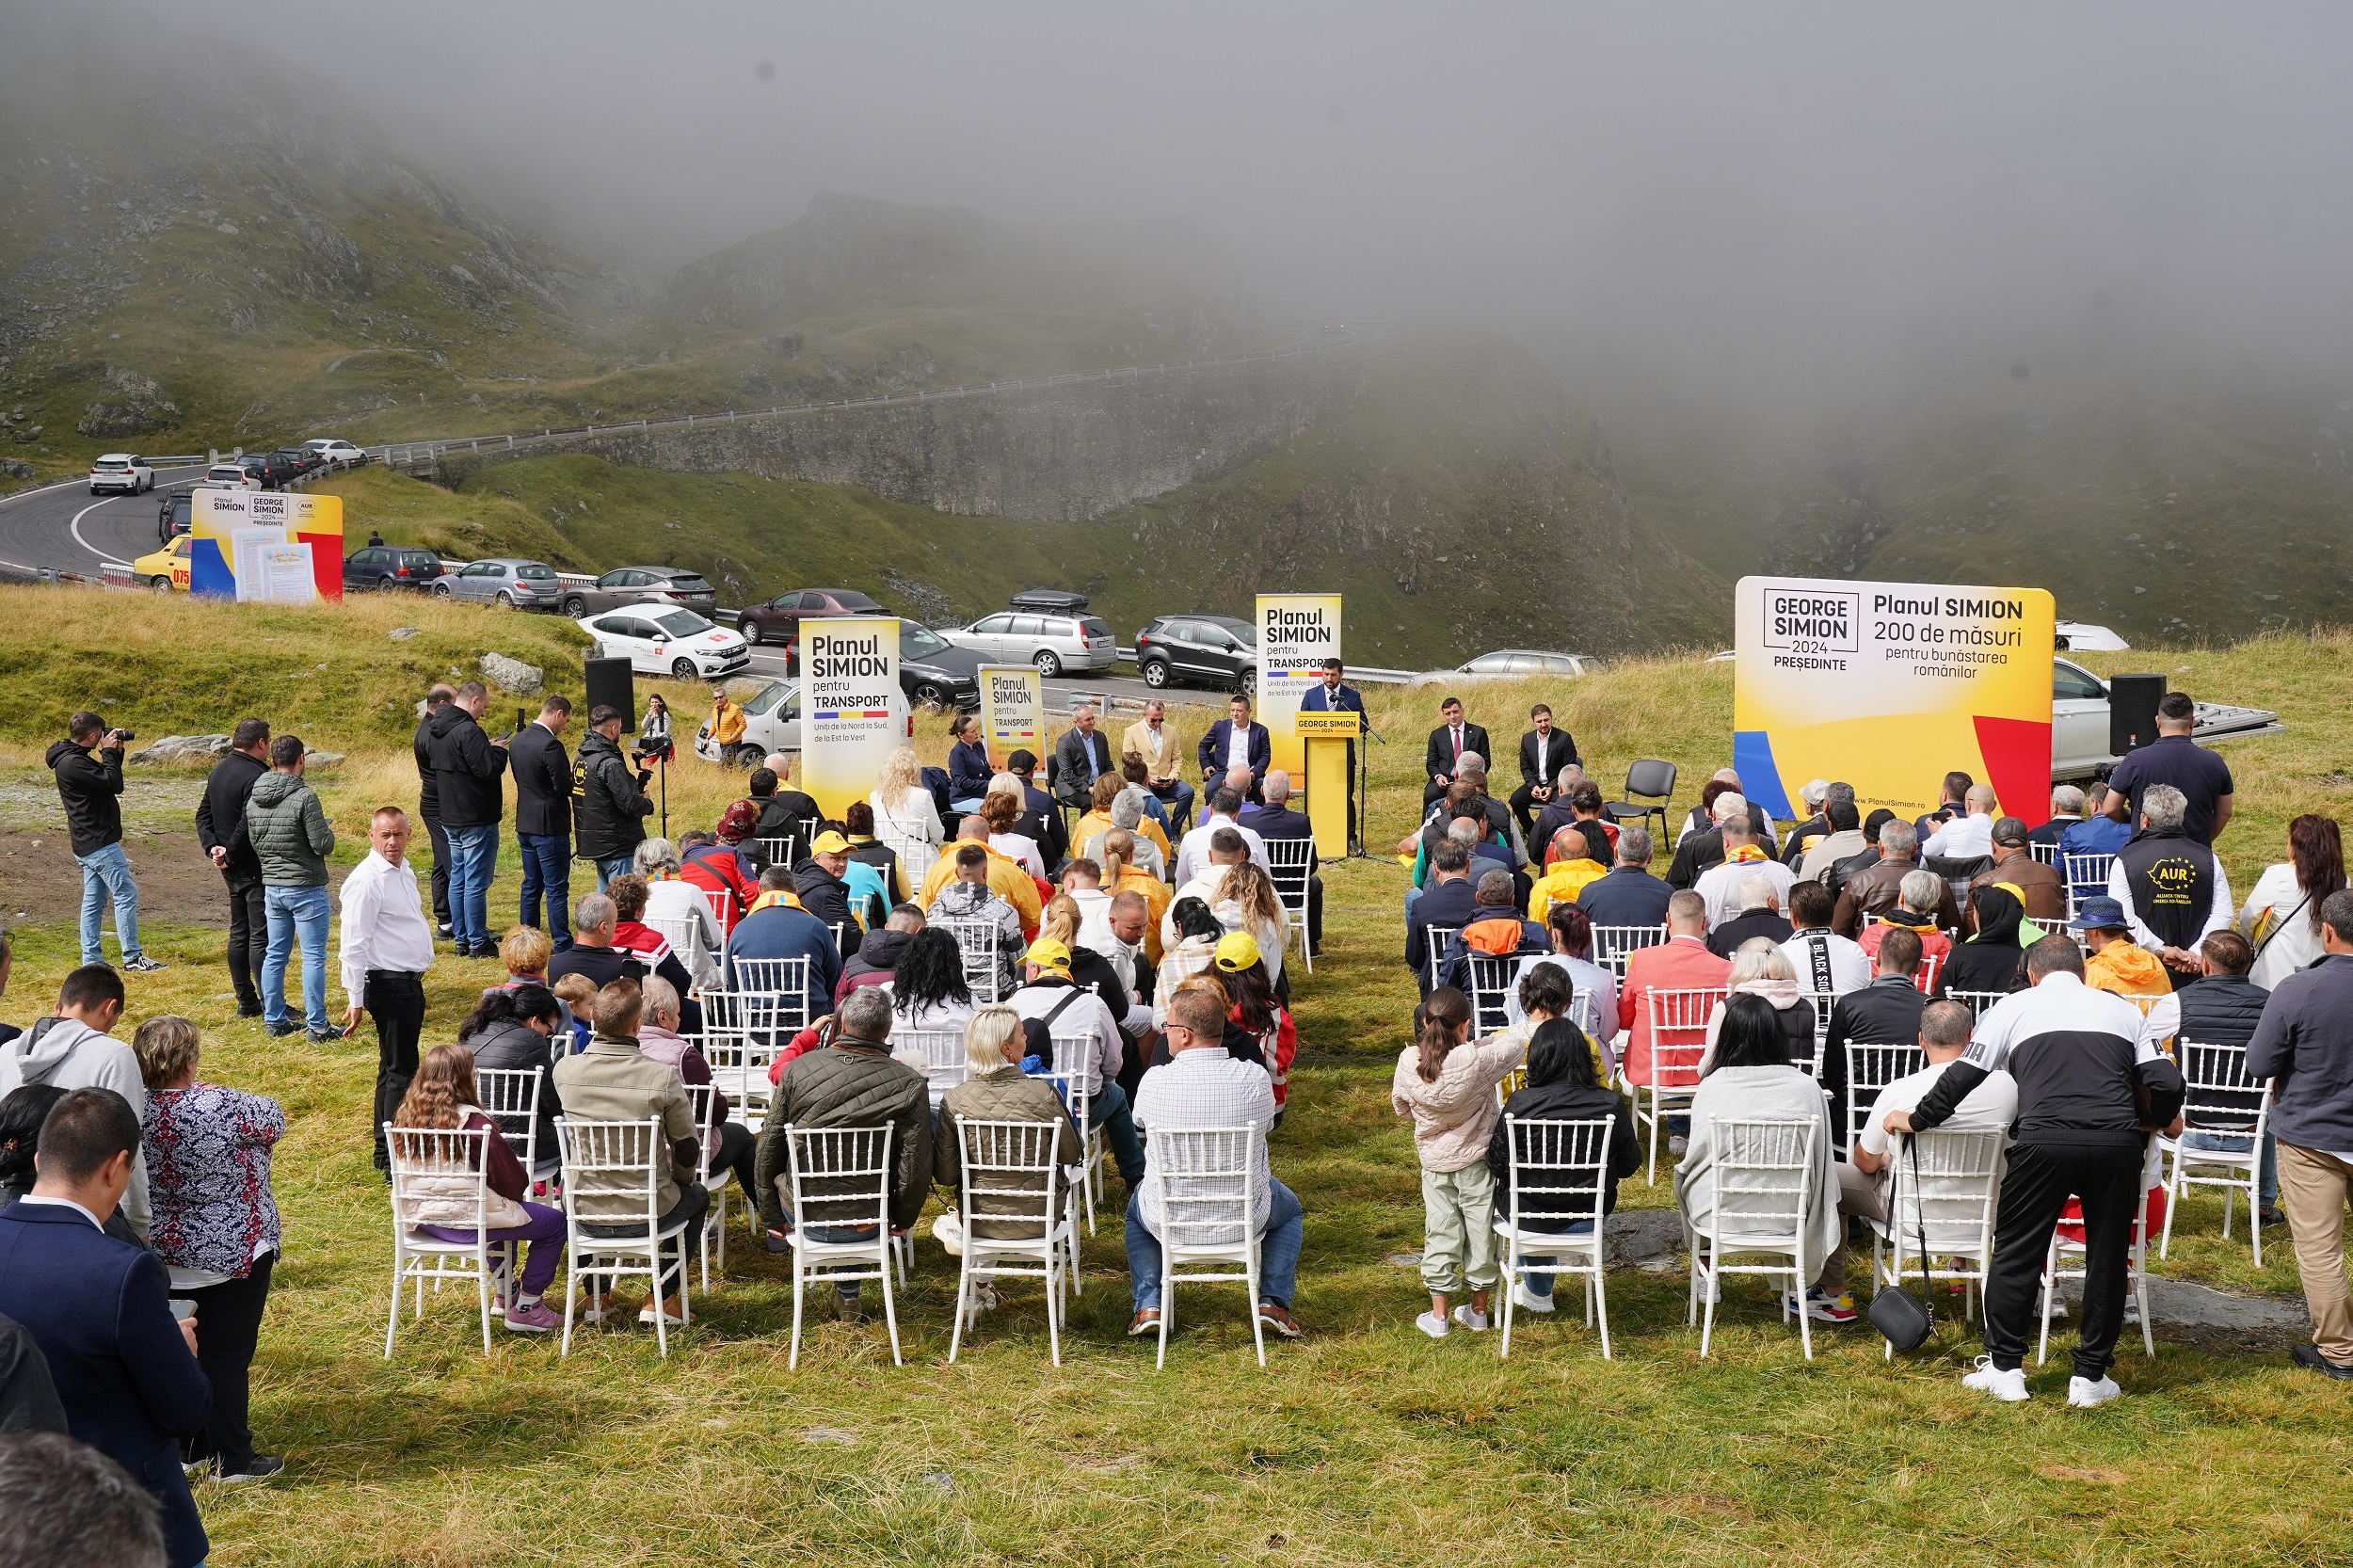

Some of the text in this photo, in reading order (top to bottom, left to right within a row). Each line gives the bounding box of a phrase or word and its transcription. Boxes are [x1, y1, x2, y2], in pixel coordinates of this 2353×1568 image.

[214, 503, 245, 512] SIMION
[253, 498, 283, 506] GEORGE
[253, 505, 284, 514] SIMION
[173, 569, 190, 584] 075
[1775, 597, 1848, 617] GEORGE
[1874, 594, 2023, 619] Planul SIMION
[1267, 608, 1322, 625] Planul
[1266, 627, 1331, 643] SIMION
[1774, 616, 1848, 639] SIMION
[1874, 621, 2022, 647] 200 de măsuri
[812, 634, 878, 656] Planul
[1267, 646, 1298, 657] pentru
[1792, 640, 1829, 654] 2024
[1267, 658, 1326, 668] TRANSPOR
[1774, 655, 1847, 671] PREȘEDINTE
[1885, 648, 2008, 664] pentru bunăstarea
[812, 657, 888, 678] SIMION
[1913, 664, 1977, 679] românilor
[813, 680, 850, 695] pentru
[992, 677, 1026, 690] Planul
[813, 695, 888, 709] TRANSPORT
[993, 691, 1032, 704] SIMION
[994, 706, 1016, 716] pentru
[994, 718, 1033, 727] TRANSPORT
[1854, 797, 1926, 809] ww.PlanulSimion.ro
[2159, 868, 2187, 881] AUR
[1813, 943, 1827, 973] BLACK
